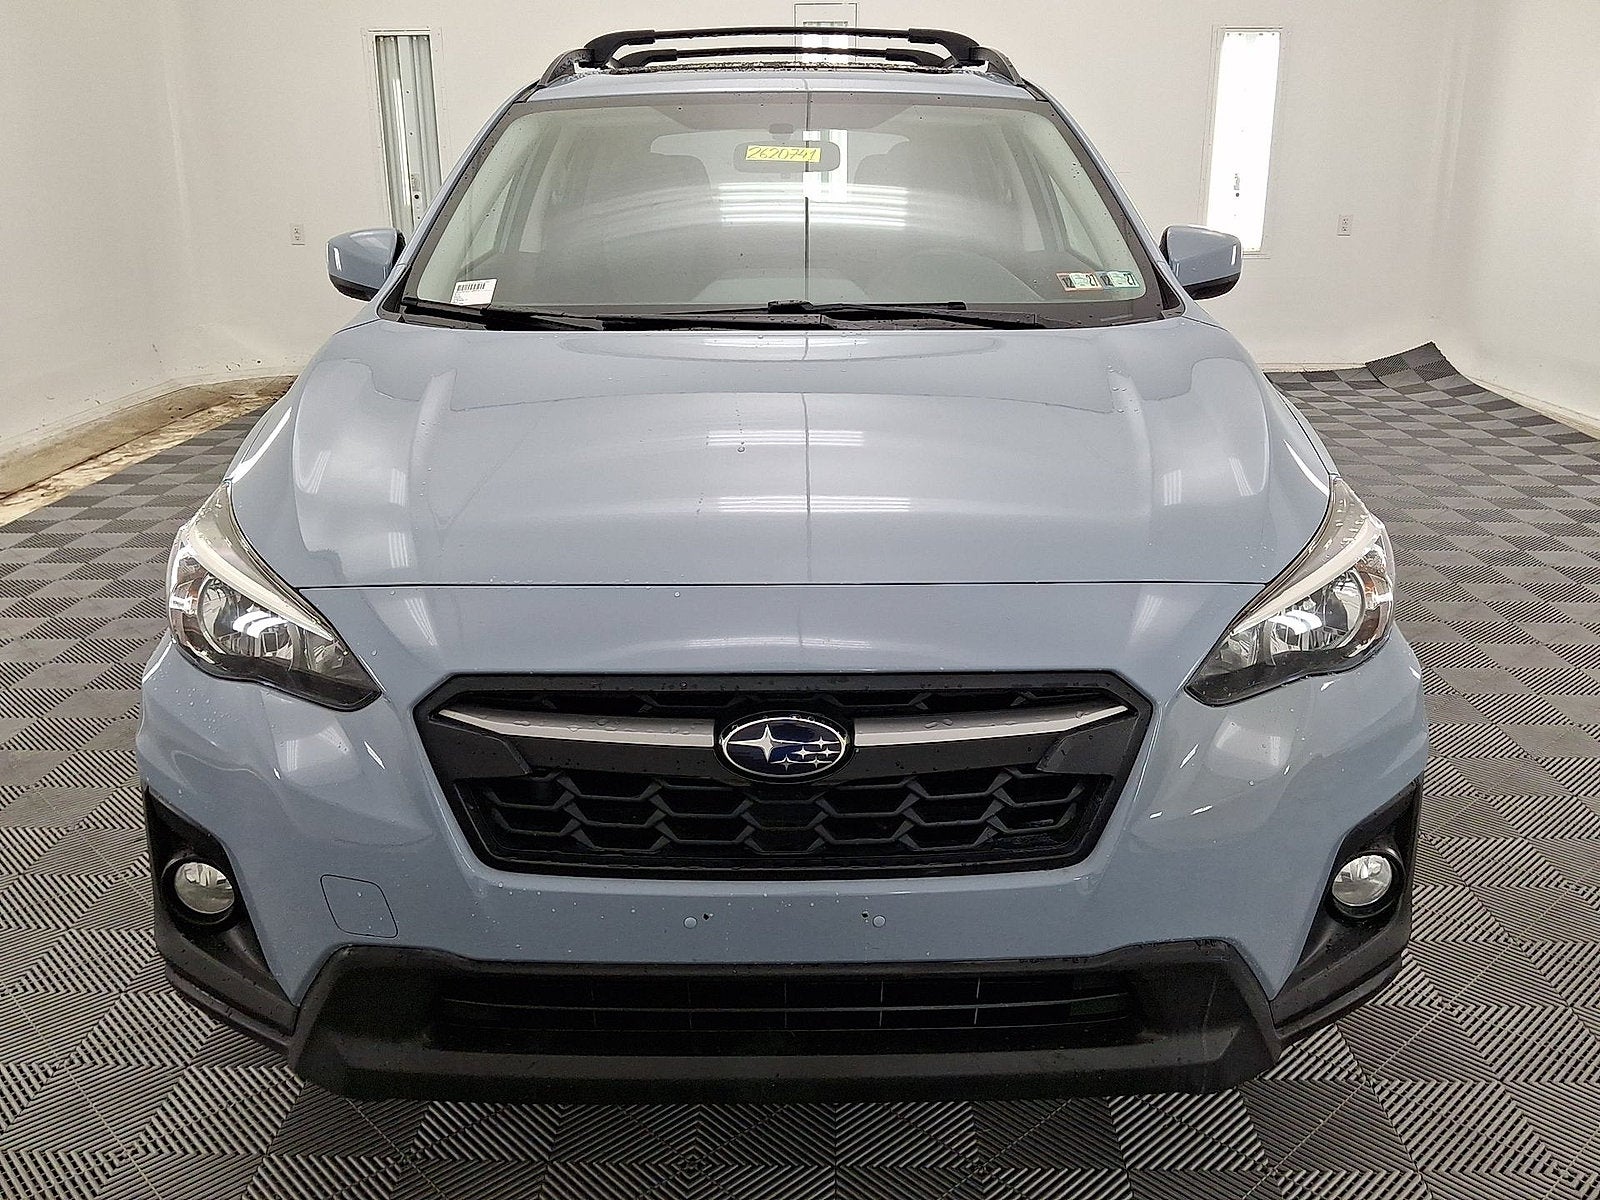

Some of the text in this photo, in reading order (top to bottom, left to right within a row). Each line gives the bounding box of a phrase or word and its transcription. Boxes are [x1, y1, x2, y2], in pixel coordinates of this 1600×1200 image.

[747, 146, 817, 161] 2620741
[1062, 274, 1098, 288] 12 27
[1100, 273, 1136, 286] 12 27
